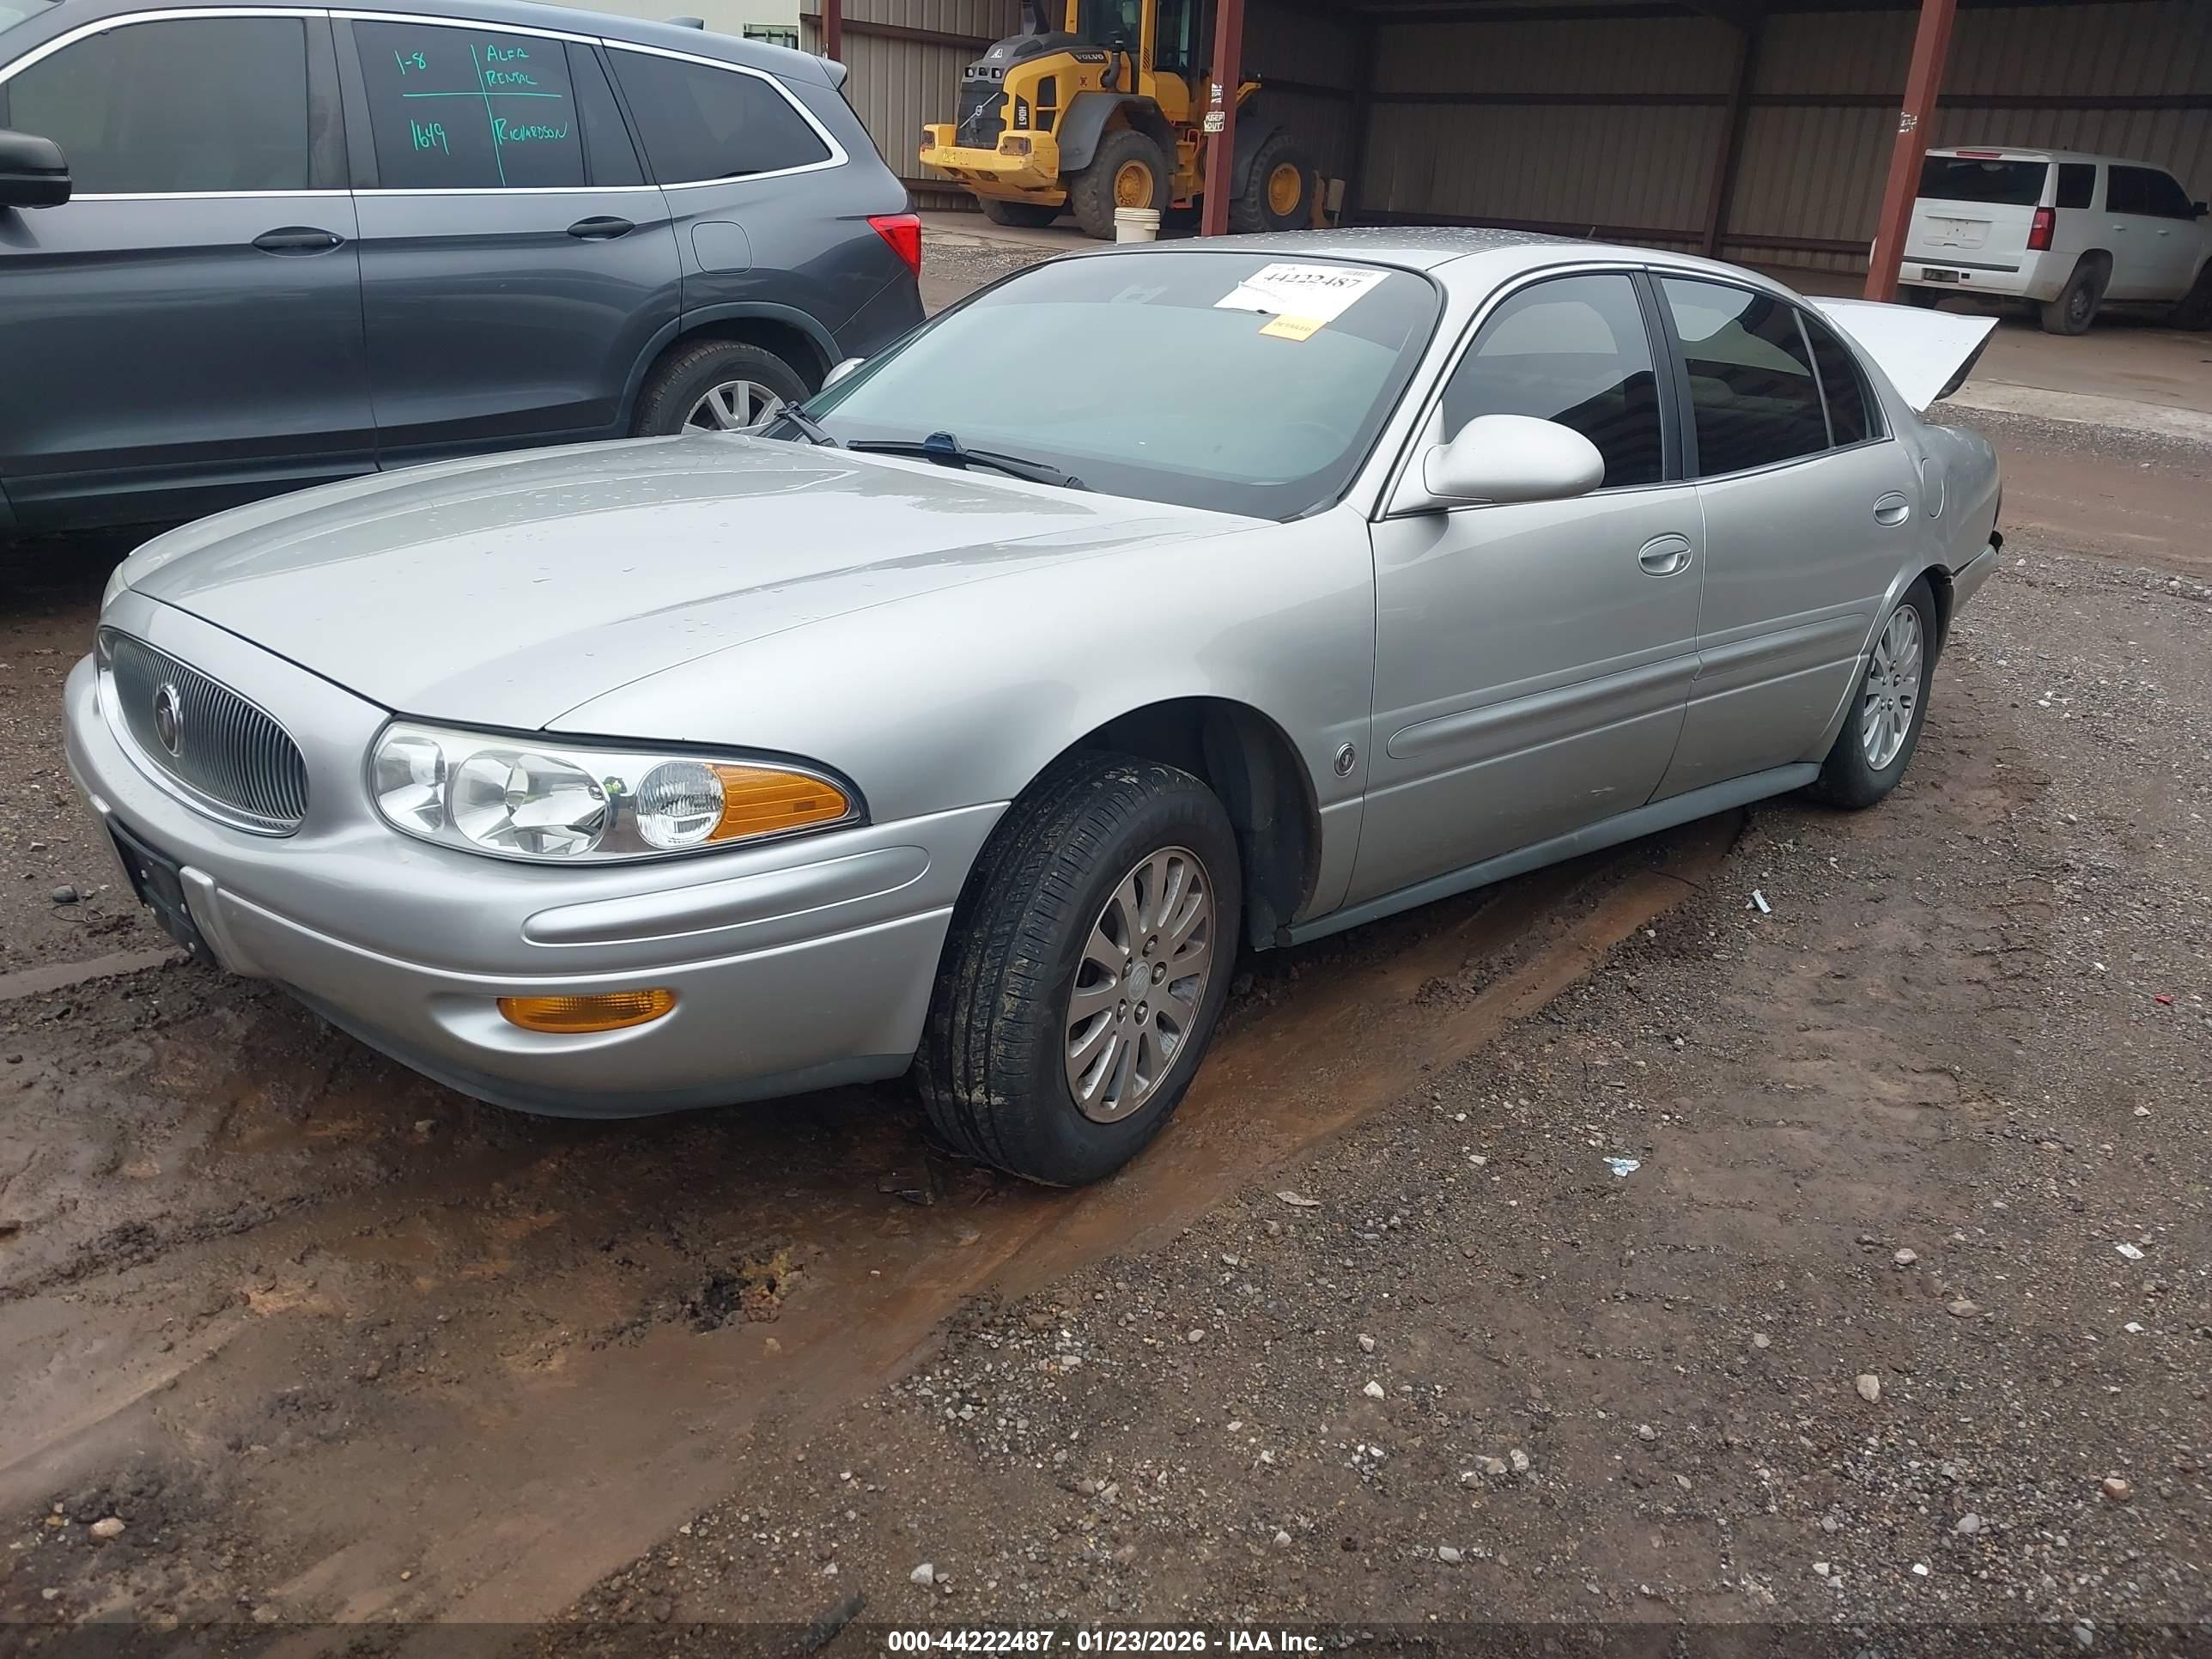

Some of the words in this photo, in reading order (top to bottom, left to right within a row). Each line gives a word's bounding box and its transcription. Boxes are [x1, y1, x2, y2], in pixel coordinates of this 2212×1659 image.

[394, 49, 427, 76] 1-8
[485, 70, 538, 87] RENTAL
[1018, 106, 1027, 125] L90H
[410, 118, 450, 155] 1649
[1264, 273, 1363, 289] 44222487
